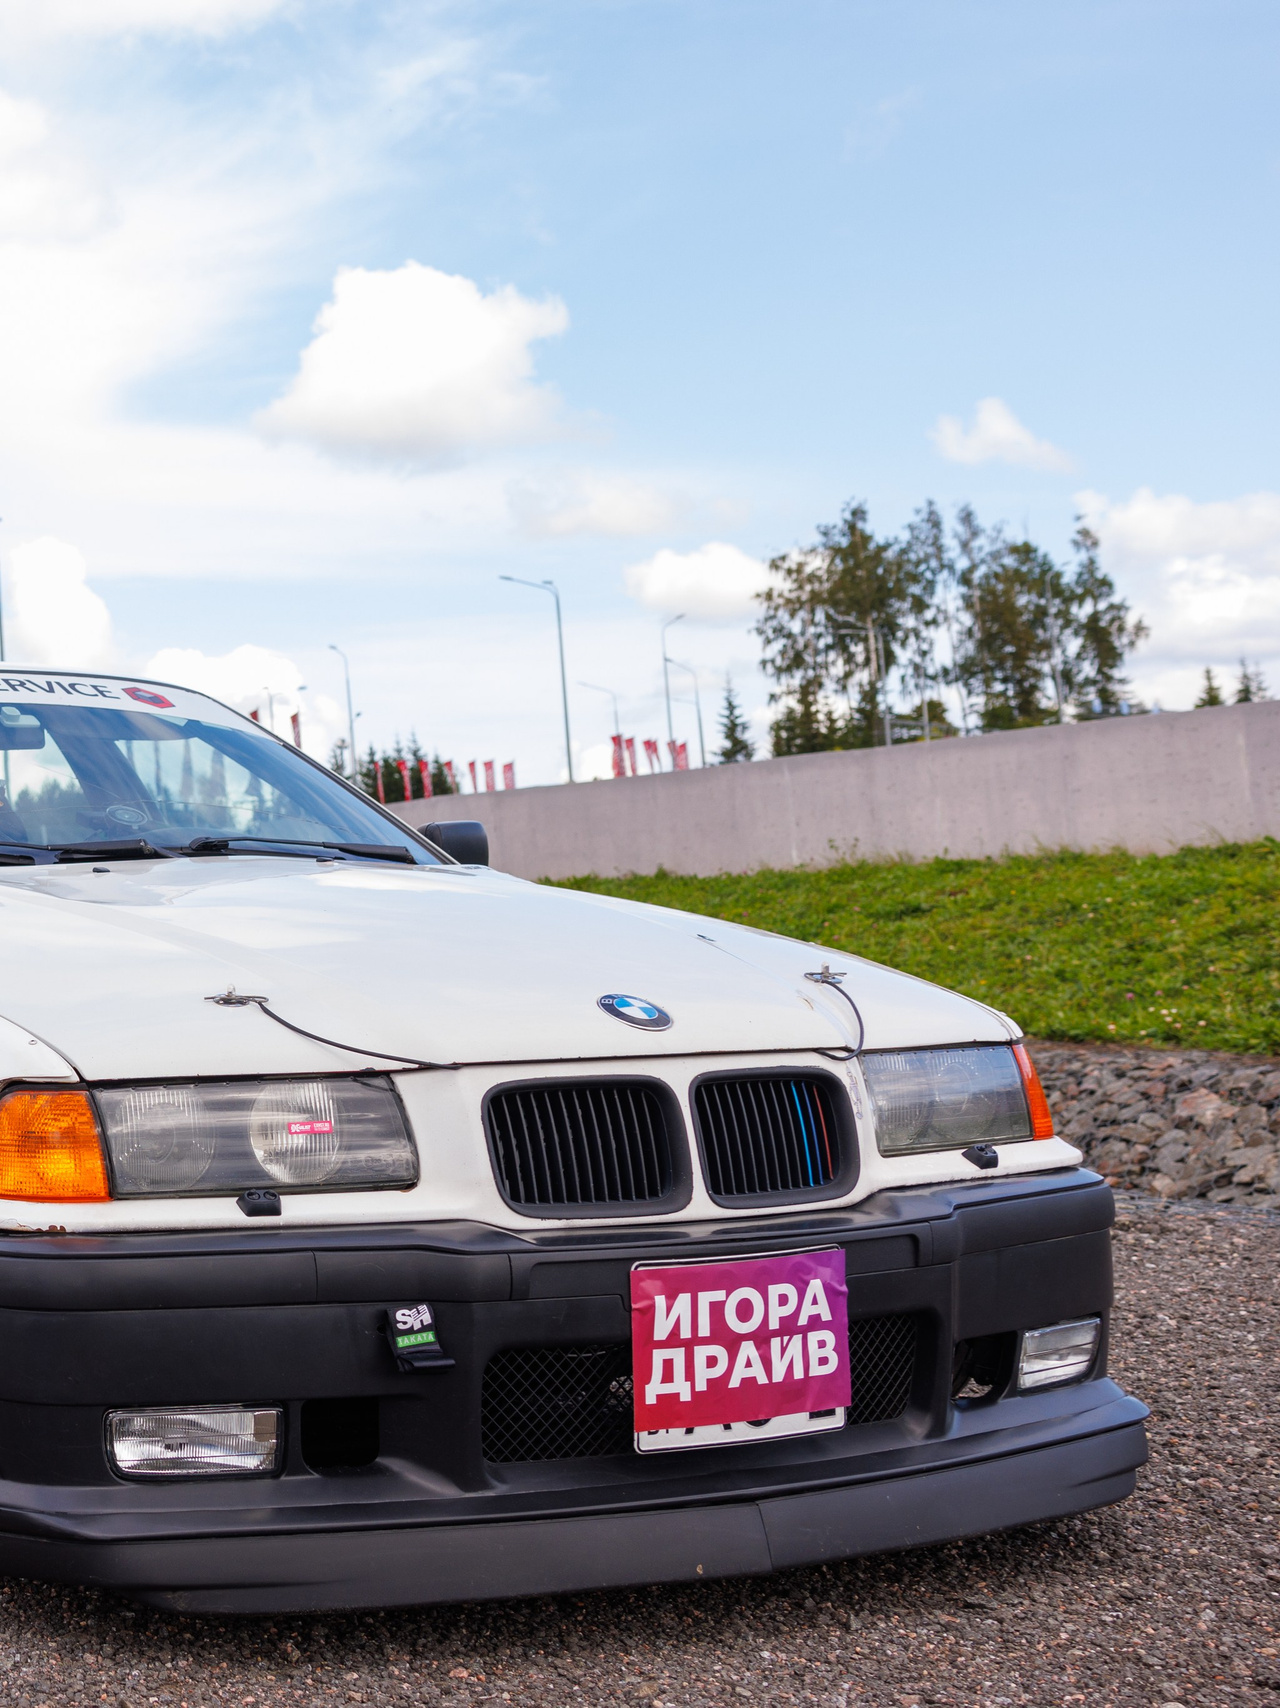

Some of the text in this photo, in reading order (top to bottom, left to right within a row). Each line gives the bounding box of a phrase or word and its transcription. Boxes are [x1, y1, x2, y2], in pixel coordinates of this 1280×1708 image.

[397, 1333, 434, 1345] TAKATA
[653, 1278, 833, 1341] ИГОРА
[645, 1330, 839, 1405] ДРАЙВ
